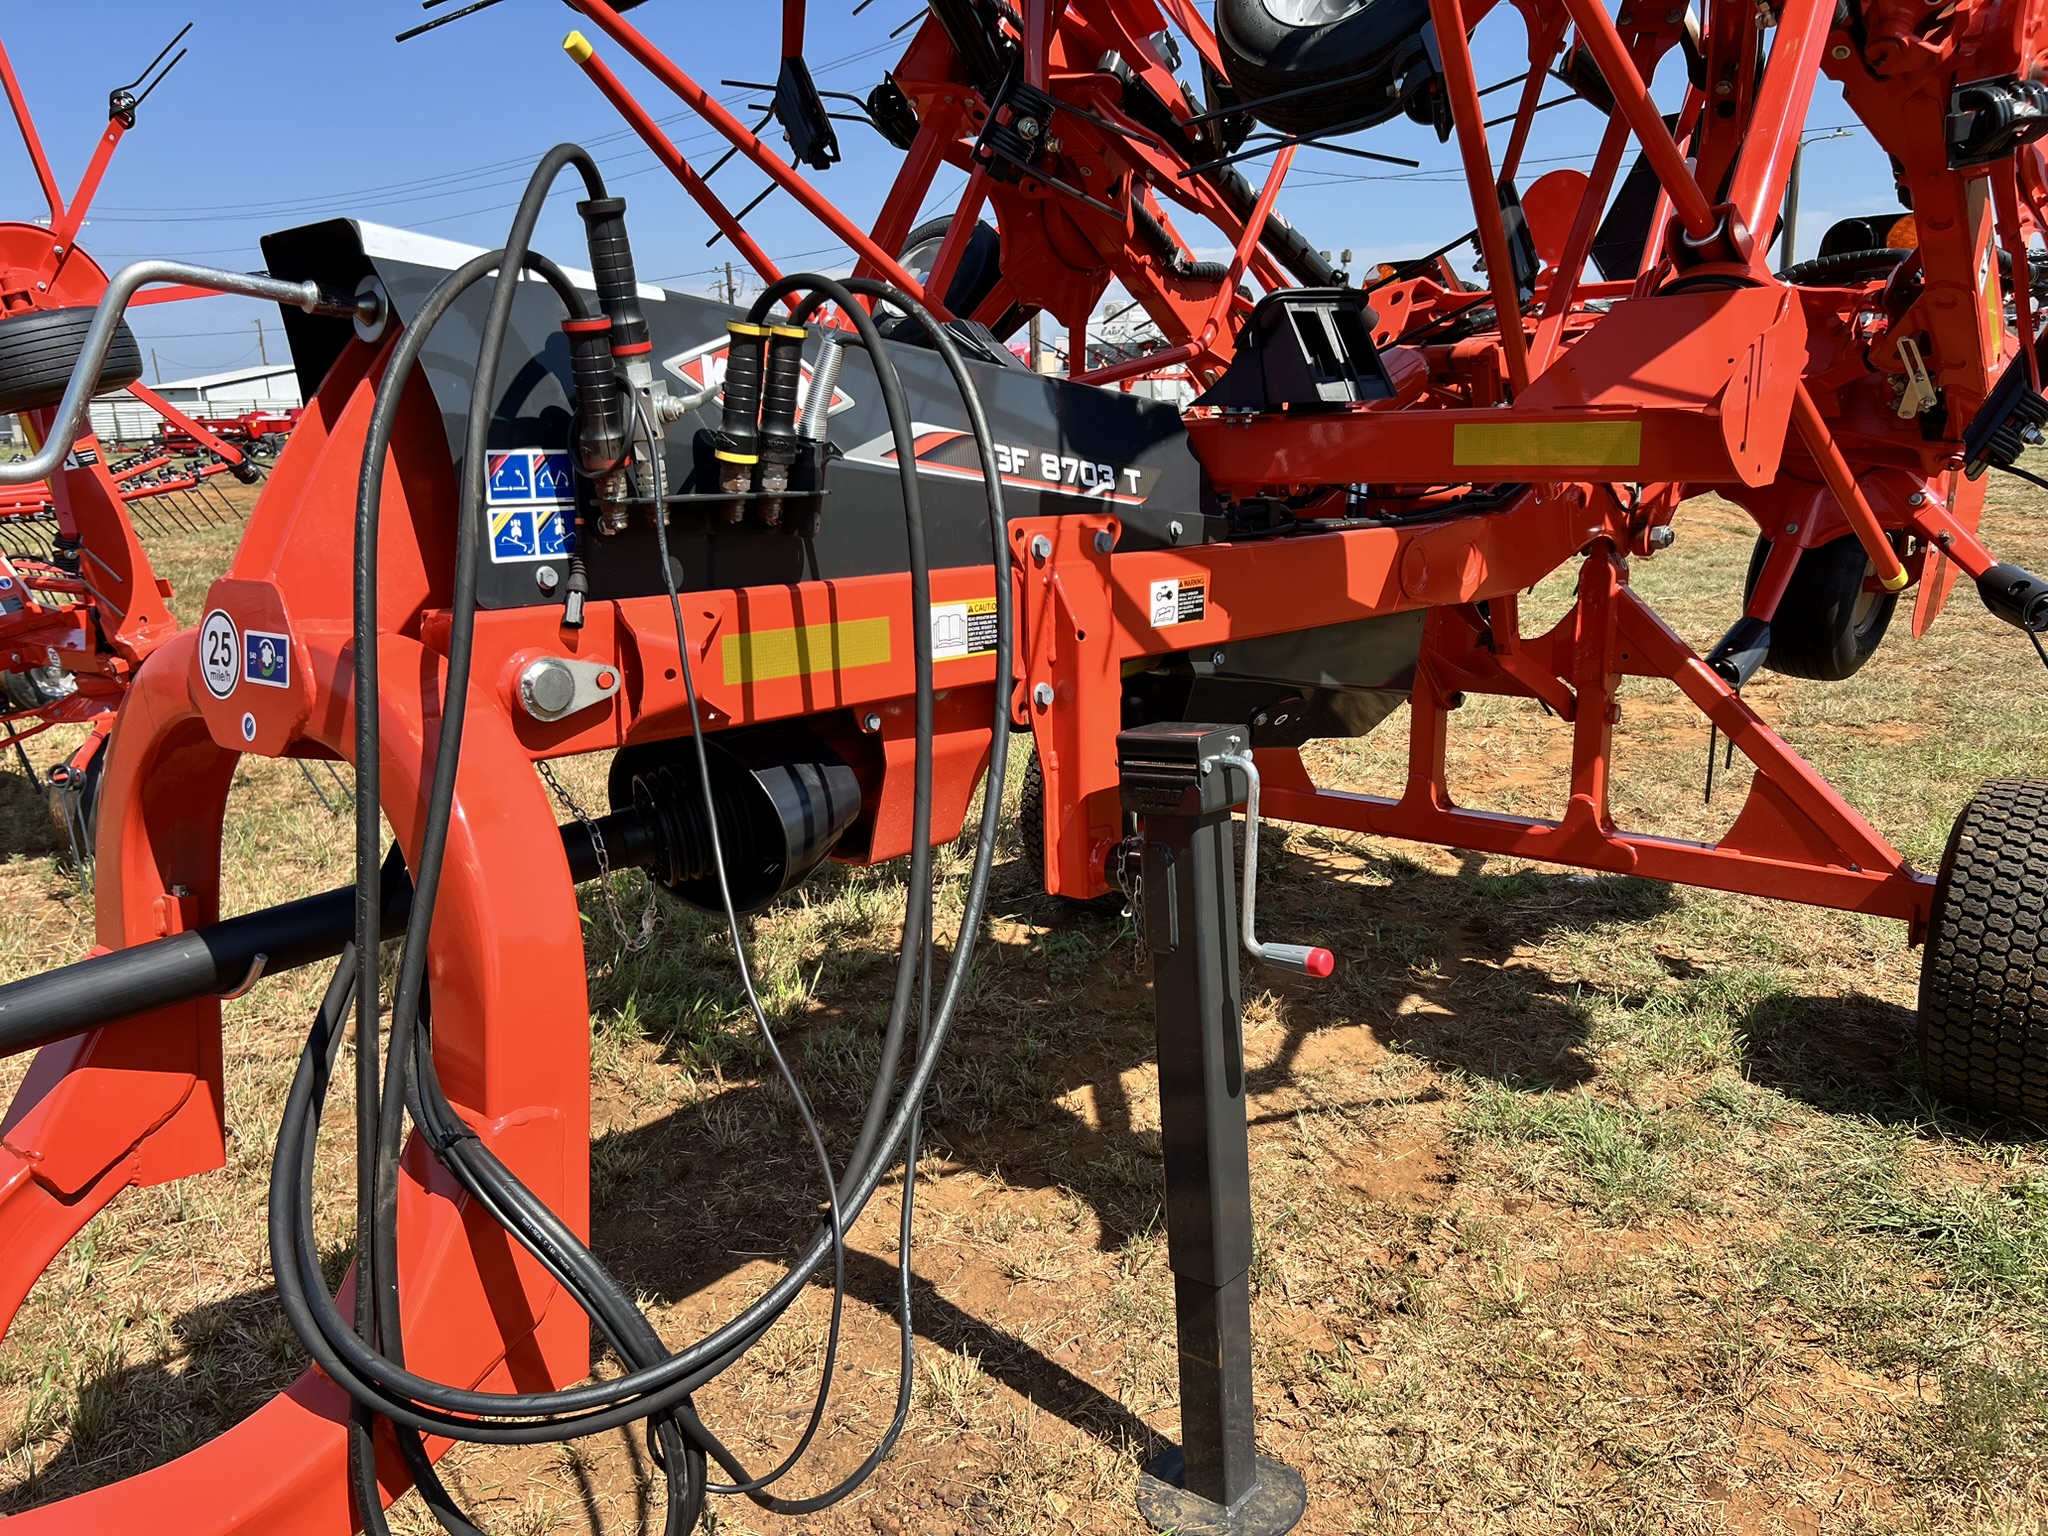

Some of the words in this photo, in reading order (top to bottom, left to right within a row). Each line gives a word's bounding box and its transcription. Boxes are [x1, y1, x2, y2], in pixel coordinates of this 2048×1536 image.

[1040, 453, 1116, 491] 8703
[1123, 468, 1142, 494] T
[1183, 578, 1204, 587] WARNING
[974, 602, 998, 612] CAUTIO
[208, 630, 232, 668] 25
[209, 669, 231, 682] mile/h
